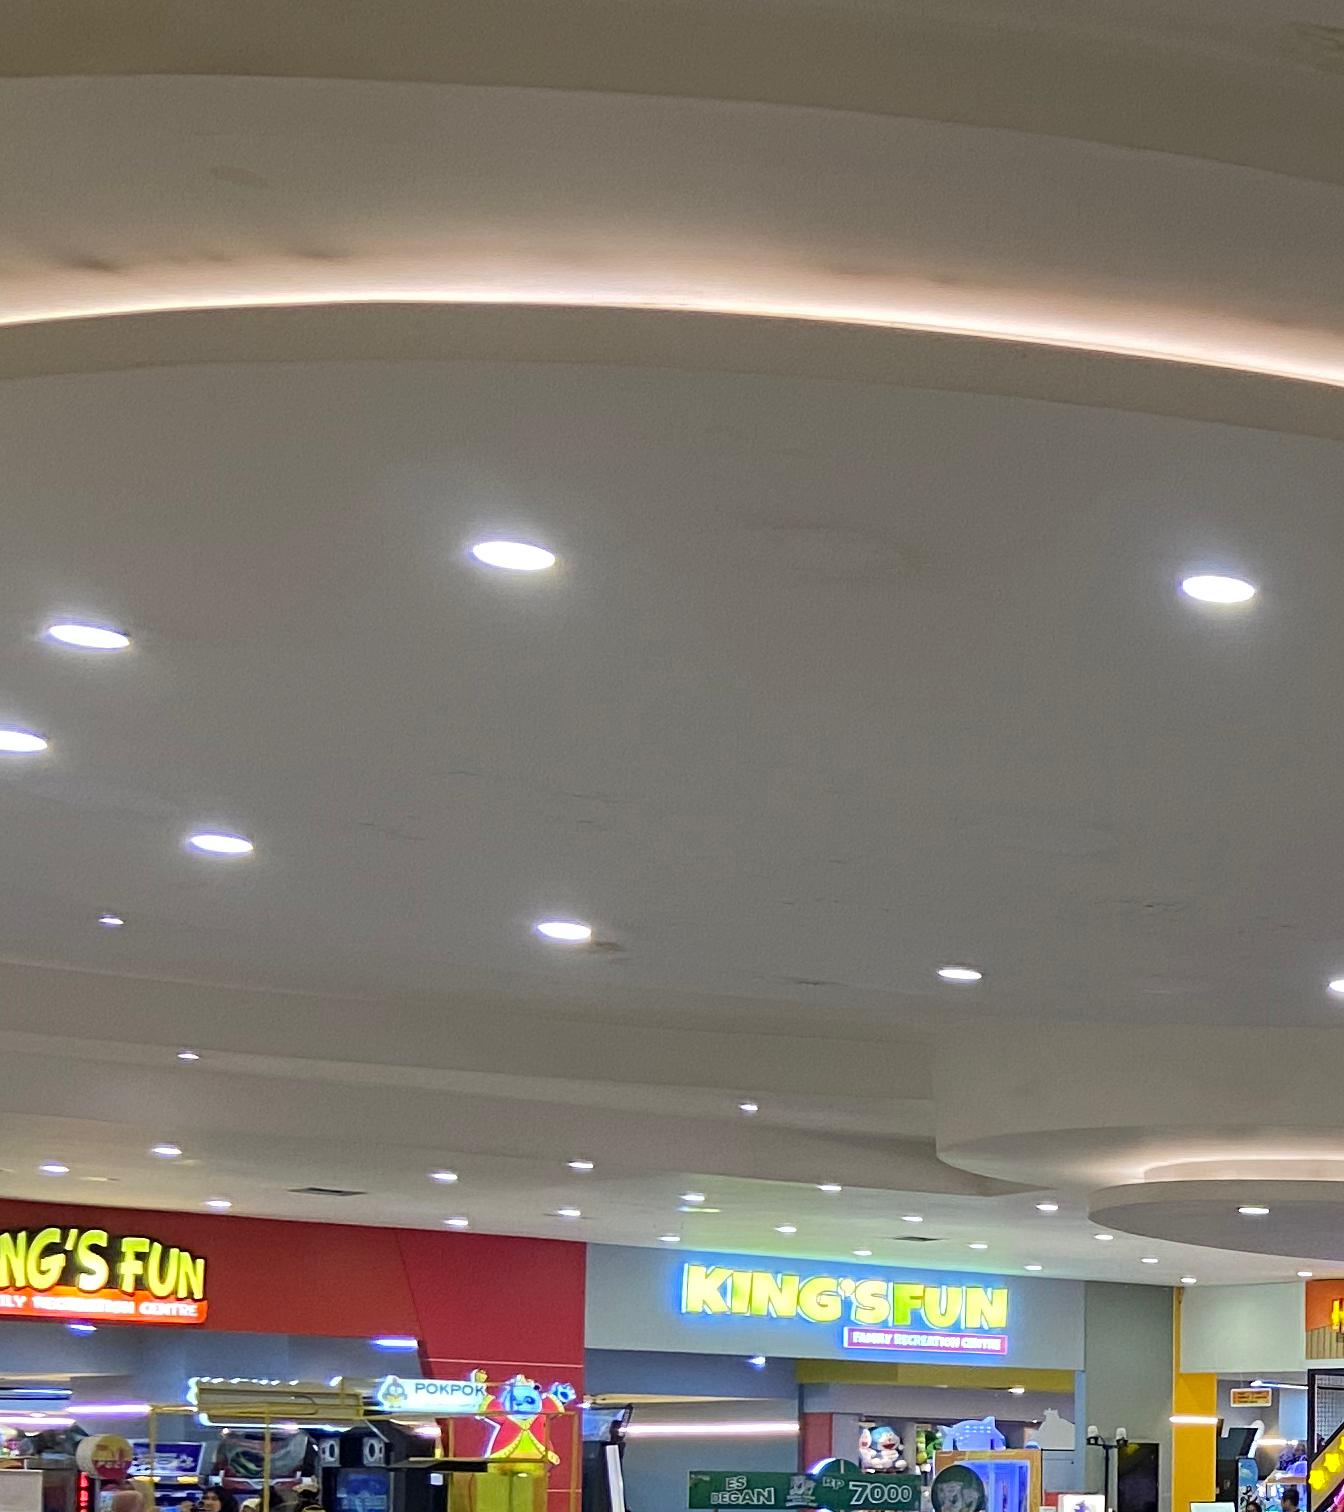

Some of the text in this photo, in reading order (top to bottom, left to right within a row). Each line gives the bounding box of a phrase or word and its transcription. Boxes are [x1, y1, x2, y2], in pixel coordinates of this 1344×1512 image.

[119, 1237, 205, 1299] FUN
[682, 1263, 1008, 1330] KING'S FUN
[415, 1382, 485, 1396] POKPOK
[726, 1476, 746, 1490] ES
[711, 1487, 774, 1505] DEGAN
[849, 1482, 911, 1505] 7000
